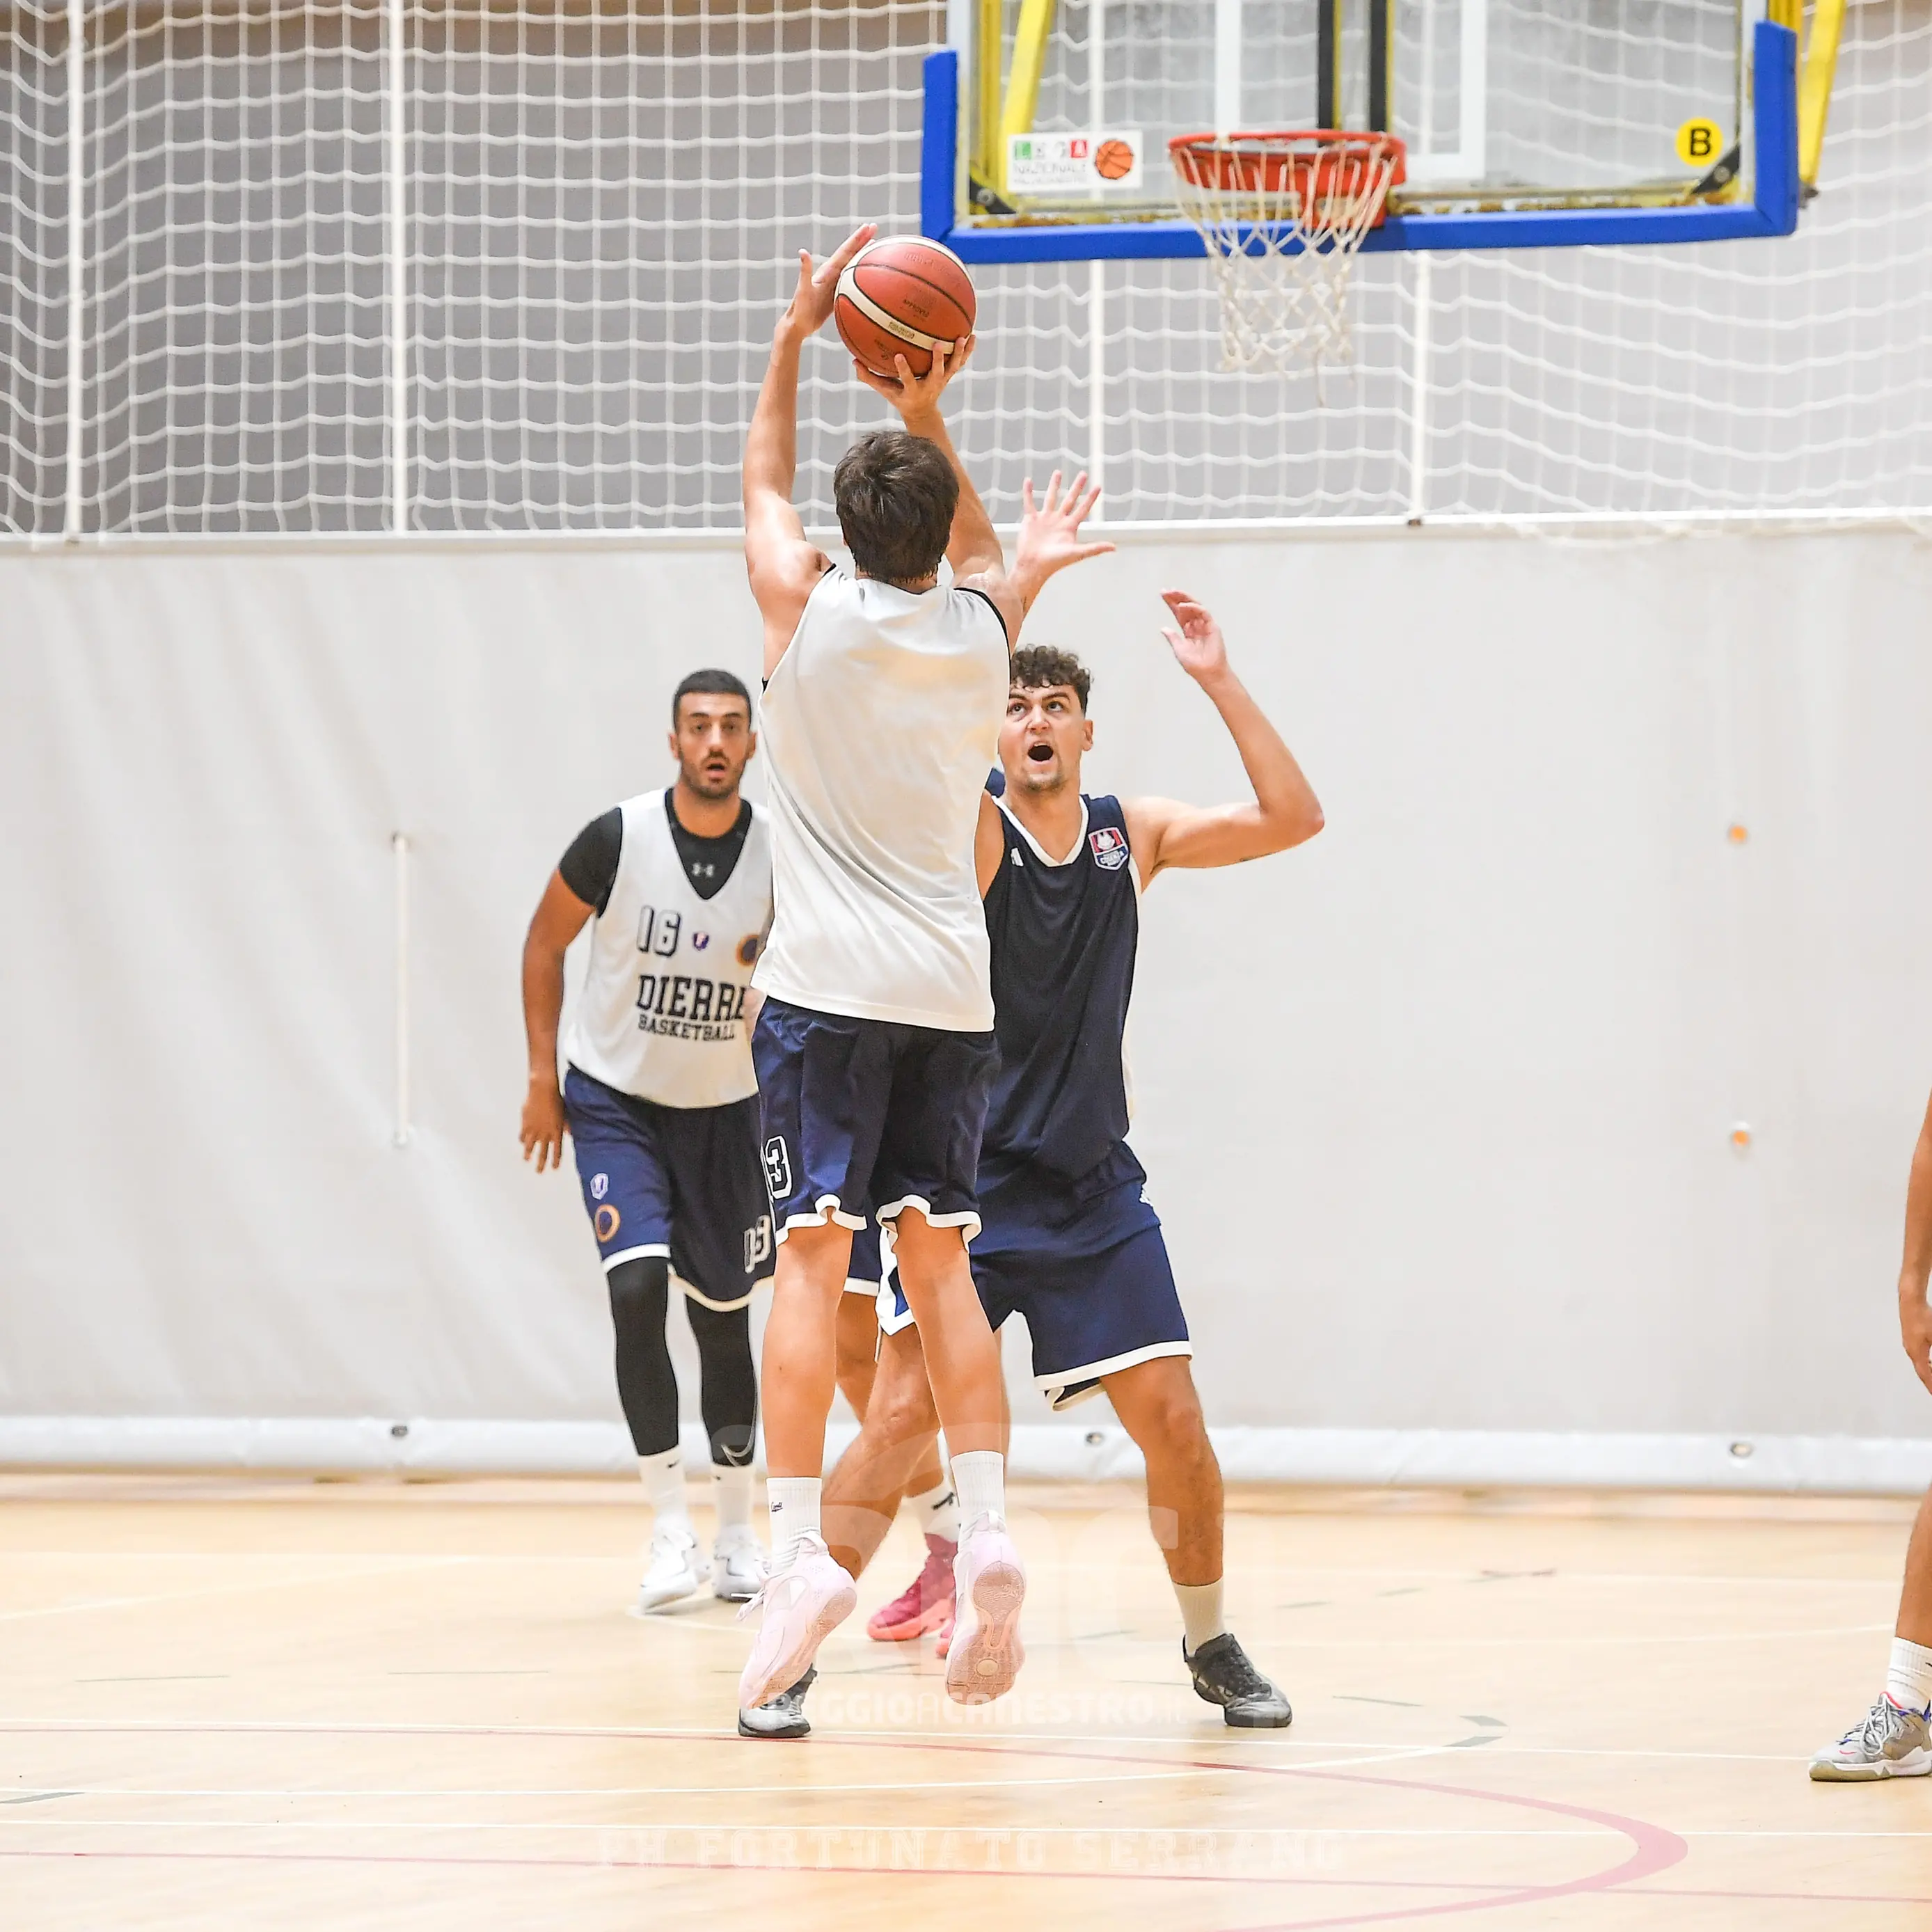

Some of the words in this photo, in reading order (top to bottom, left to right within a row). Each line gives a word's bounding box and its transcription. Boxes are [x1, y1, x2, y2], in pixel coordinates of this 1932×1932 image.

[1690, 128, 1711, 156] B
[637, 905, 681, 957] 16
[638, 1014, 735, 1041] BASKETBALL
